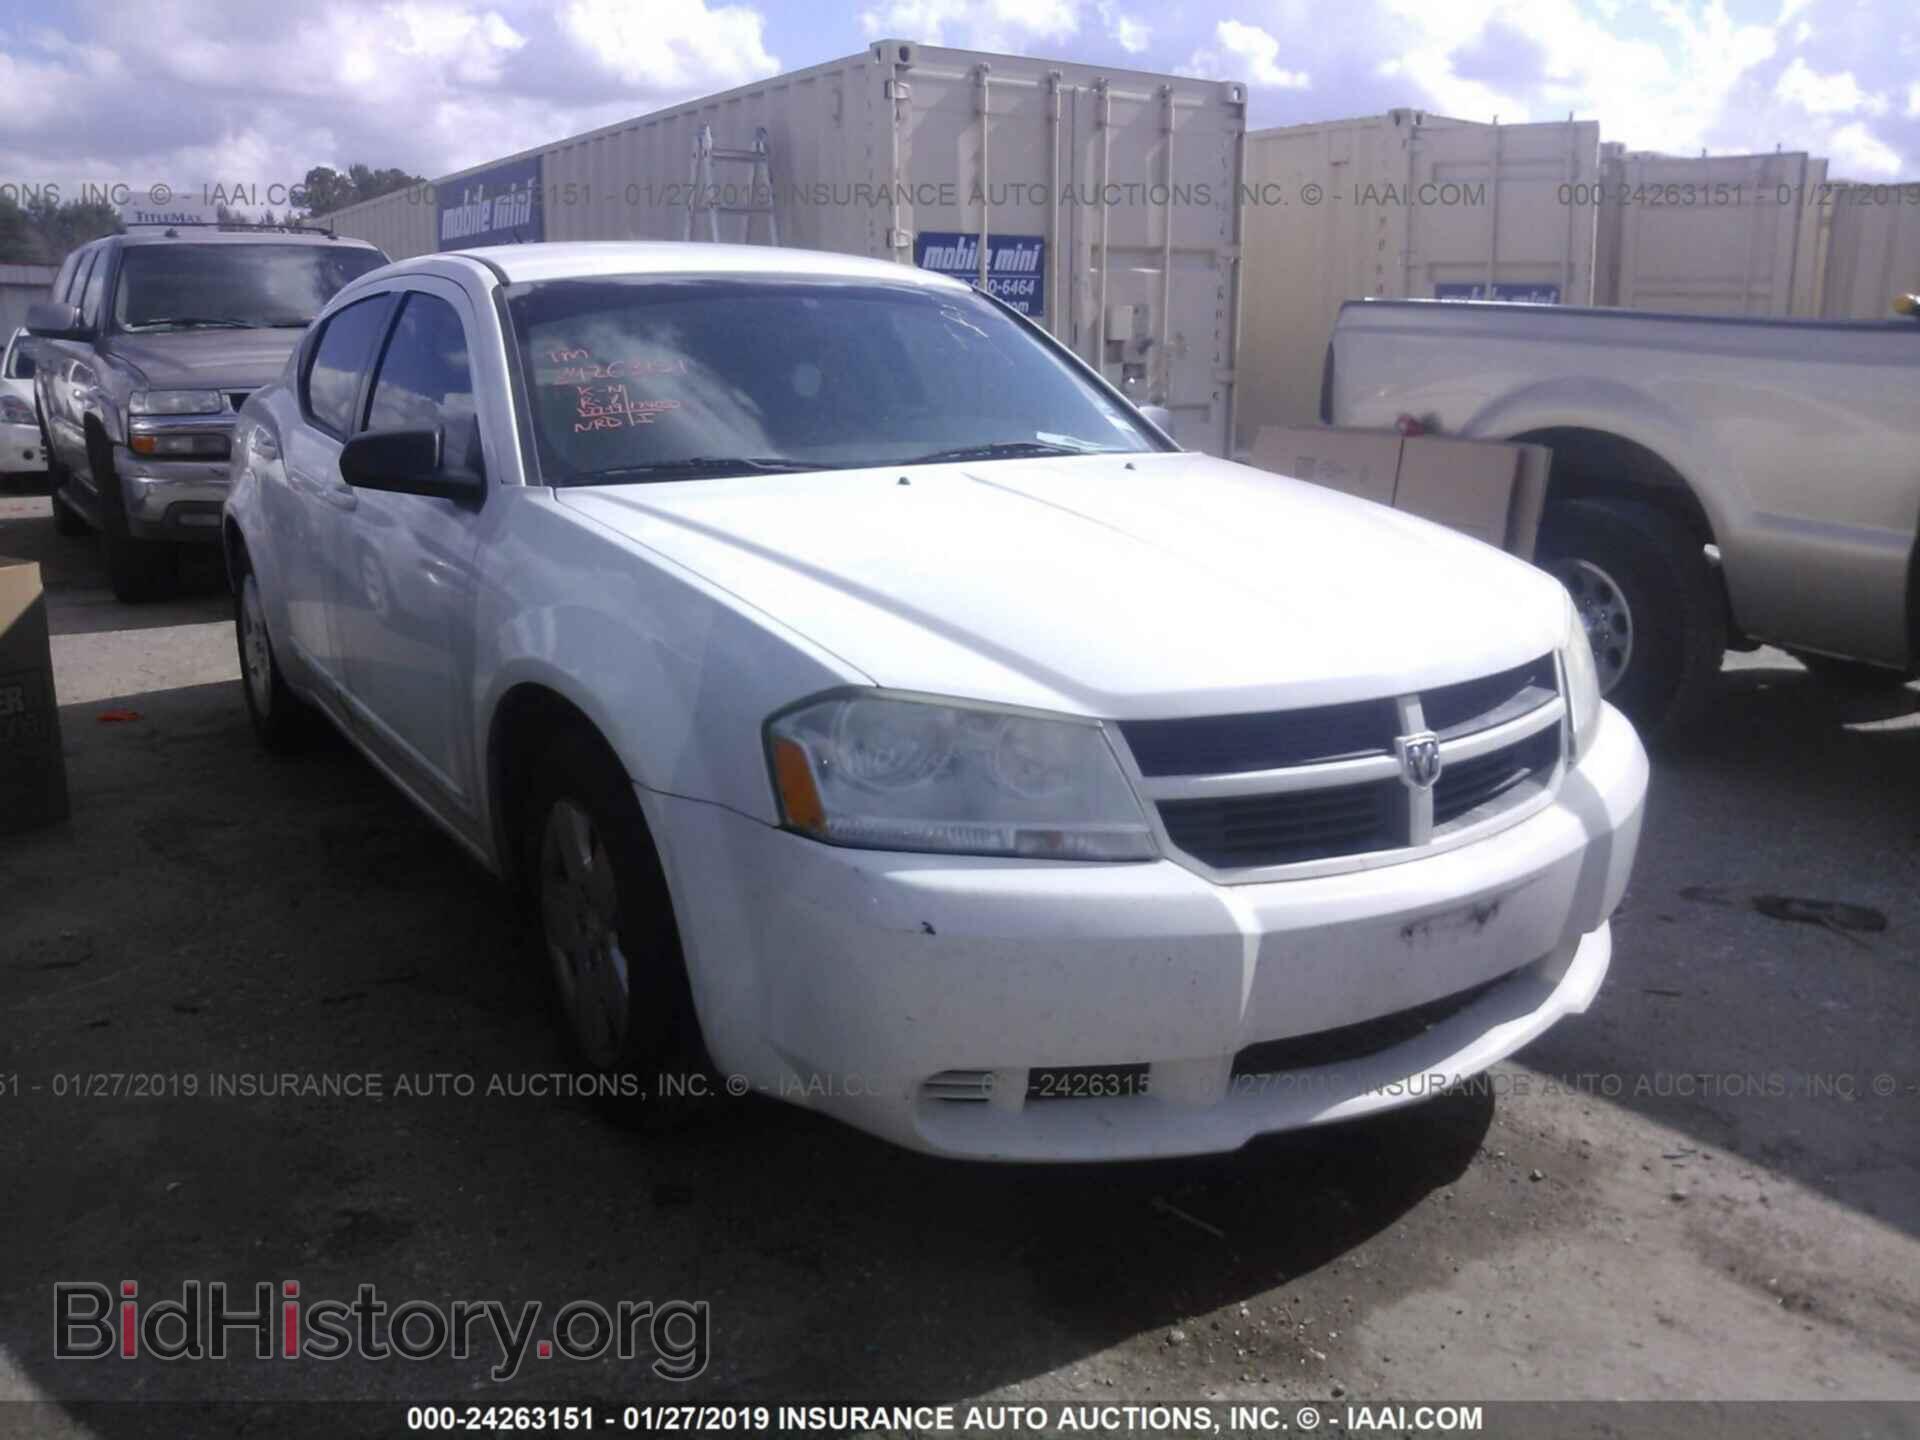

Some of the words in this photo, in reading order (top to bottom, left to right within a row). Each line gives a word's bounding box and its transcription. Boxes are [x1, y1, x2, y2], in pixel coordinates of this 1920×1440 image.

[442, 184, 491, 240] mobile
[493, 177, 533, 230] mini
[994, 243, 1041, 271] mini
